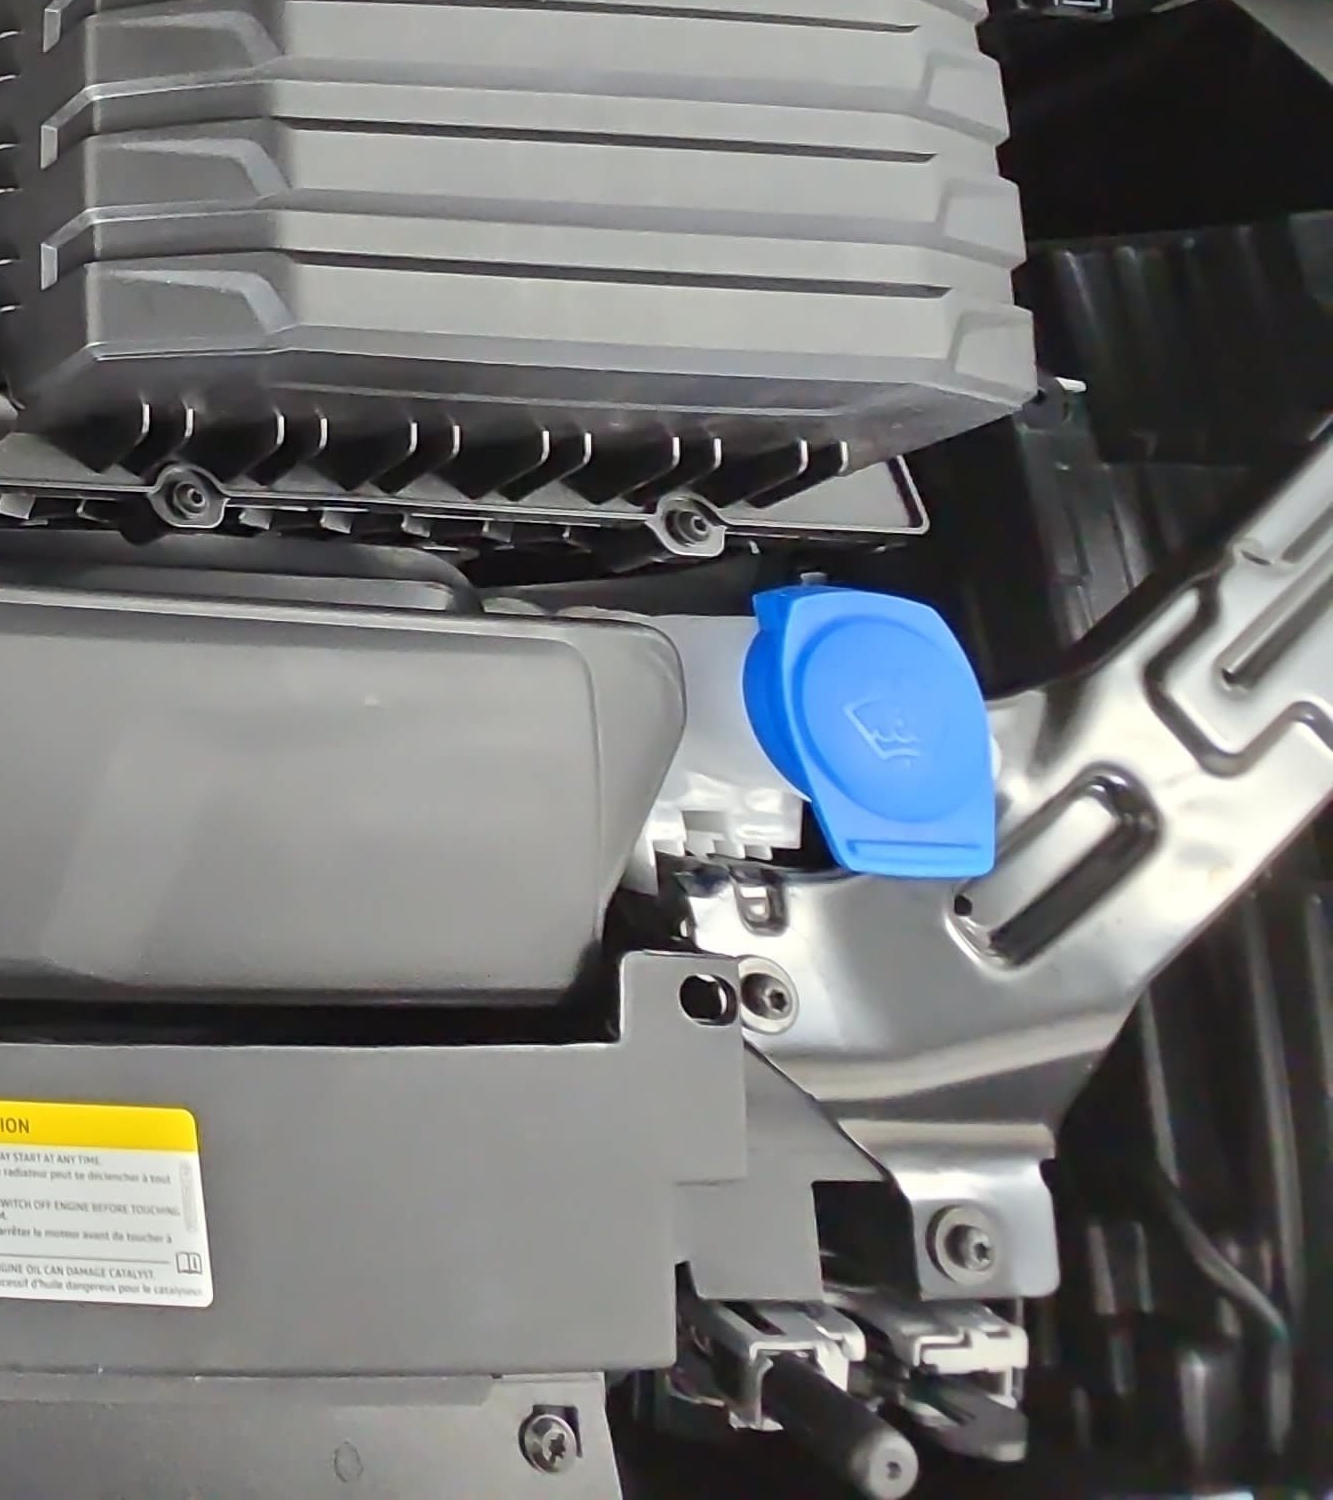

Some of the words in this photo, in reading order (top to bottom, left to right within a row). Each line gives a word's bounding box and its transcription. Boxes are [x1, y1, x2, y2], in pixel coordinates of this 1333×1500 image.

[13, 1152, 40, 1162] START
[44, 1153, 54, 1162] AT
[57, 1154, 74, 1163] ANY
[33, 1200, 50, 1210] OFF
[54, 1201, 89, 1212] ENGINE
[25, 1264, 40, 1274] OIL
[44, 1265, 62, 1275] CAN
